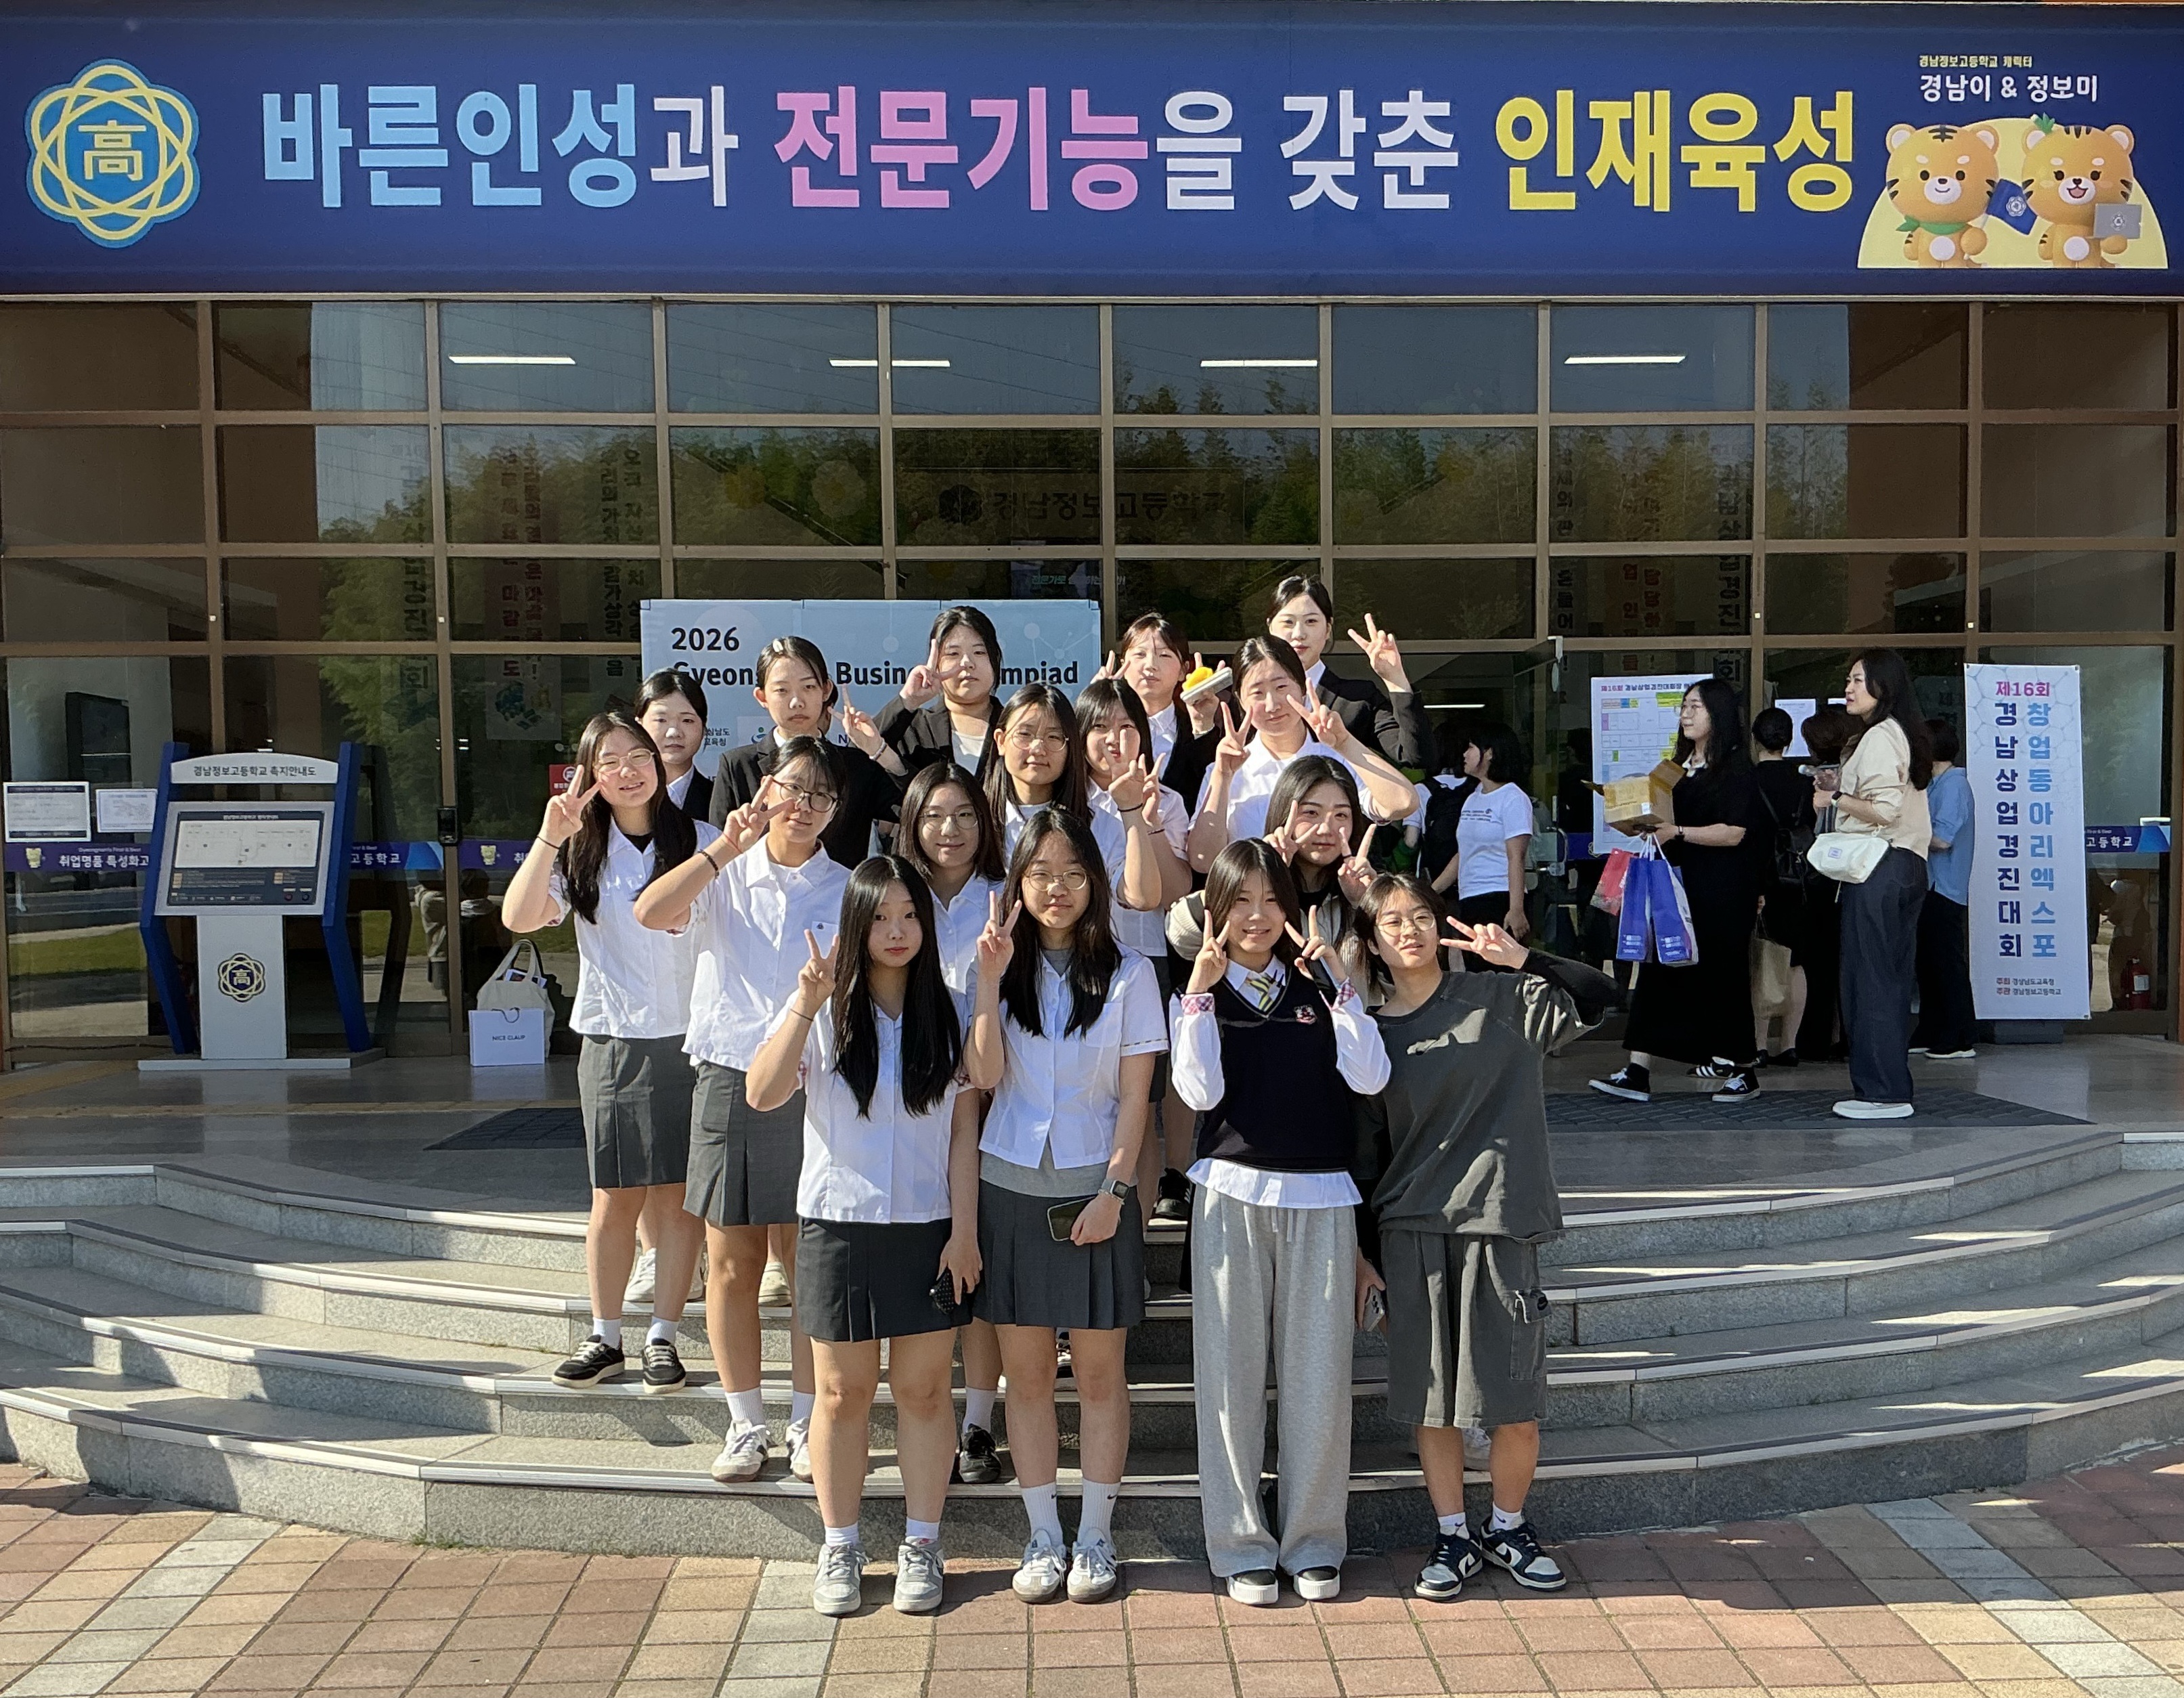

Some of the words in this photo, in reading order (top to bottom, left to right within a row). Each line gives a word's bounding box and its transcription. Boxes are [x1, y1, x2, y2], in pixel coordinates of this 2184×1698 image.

[1919, 55, 1997, 68] 경남정보고등학교
[2003, 55, 2032, 68] 캐릭터
[1920, 74, 1991, 102] 경남이
[2001, 76, 2018, 98] &
[2027, 75, 2097, 102] 정보미
[79, 120, 146, 181] 高
[263, 84, 738, 207] 바른인성과
[774, 85, 1242, 211] 전문기능을
[1280, 89, 1458, 211] 갖춘
[1495, 89, 1853, 211] 인재육성
[671, 626, 740, 651] 2026
[673, 661, 759, 687] Gyeon
[836, 661, 915, 685] Busin
[1001, 661, 1078, 686] mpiad
[1995, 681, 2051, 697] 제16회
[705, 727, 730, 736] 상남도
[194, 766, 267, 777] 경남정보고등학교
[269, 766, 317, 777] 촉지안내도
[1994, 702, 2022, 958] 경남상업경진대회
[2027, 702, 2057, 958] 창업동아리엑스포
[2086, 835, 2133, 849] 고등학교
[59, 854, 103, 868] 취업명품
[106, 854, 150, 868] 특성화고
[351, 852, 401, 866] 고등학교
[232, 968, 251, 986] 高
[2012, 978, 2055, 986] 경상남도교육청
[2012, 988, 2062, 996] 경남정보고등학교
